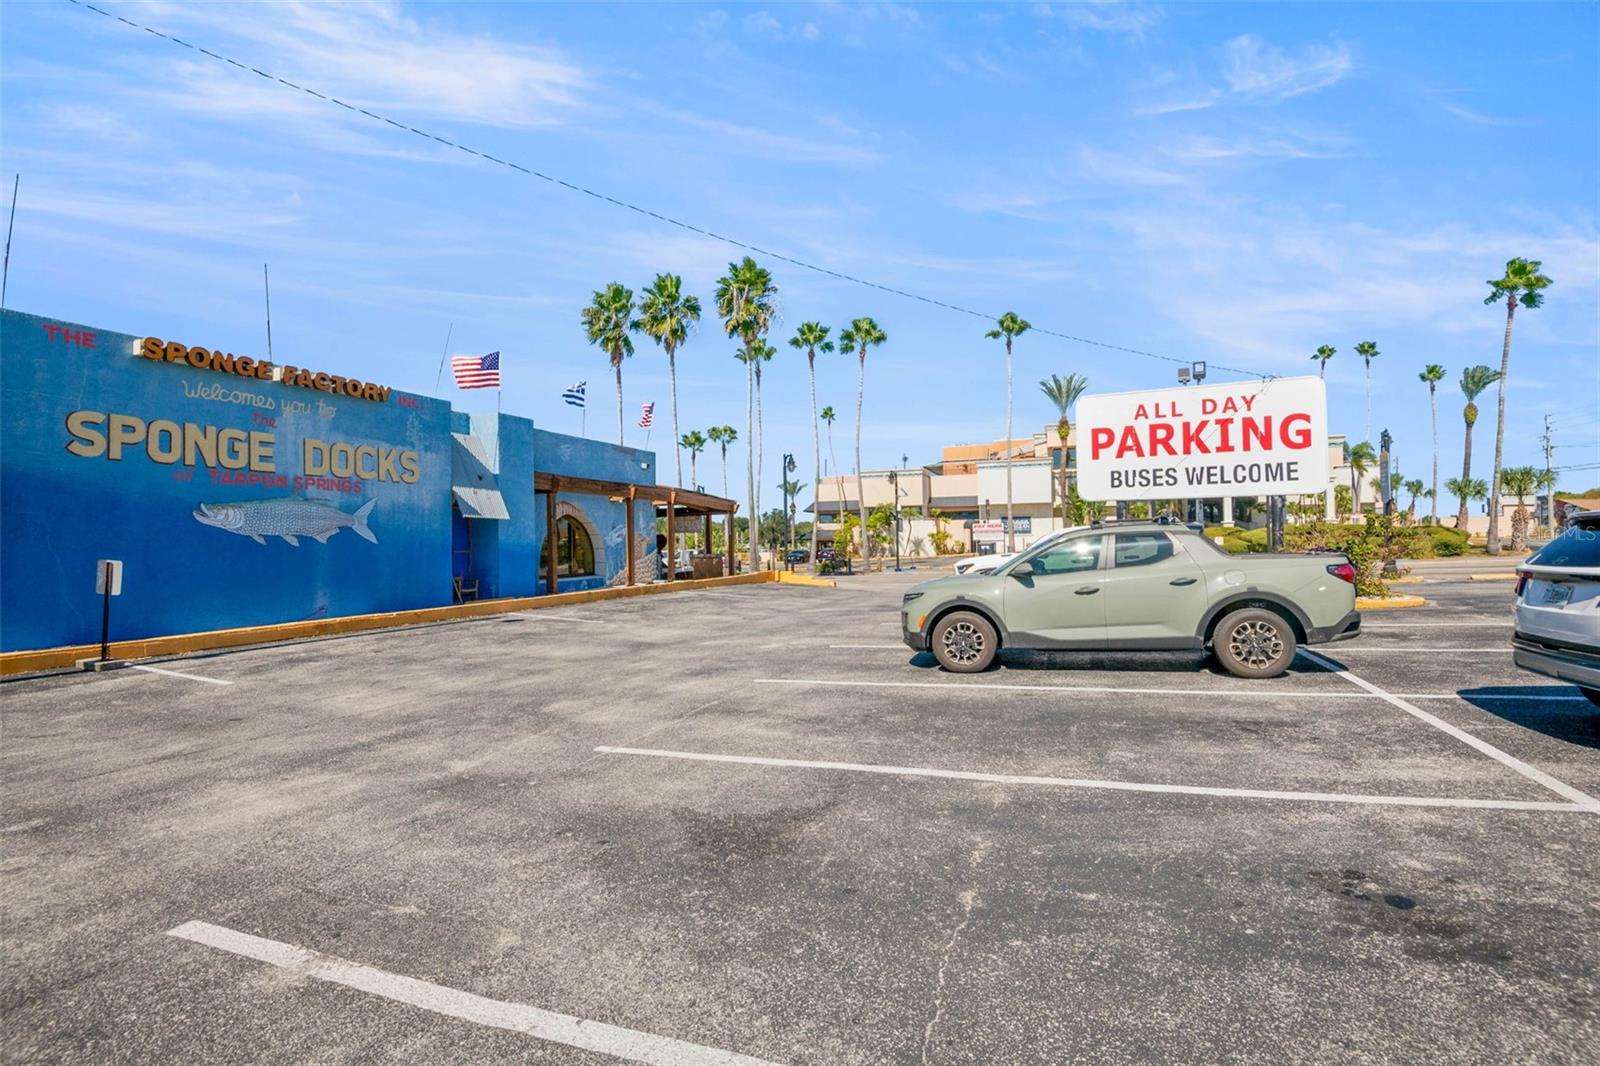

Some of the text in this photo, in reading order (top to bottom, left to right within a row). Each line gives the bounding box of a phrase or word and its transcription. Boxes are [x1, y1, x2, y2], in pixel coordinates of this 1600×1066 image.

[43, 323, 97, 349] THE
[142, 336, 274, 381] SPONGE
[282, 365, 392, 402] FACTORY
[181, 380, 336, 418] Welcomes you to
[1134, 394, 1256, 421] ALL DAY
[65, 410, 420, 484] SPONGE DOCKS
[1090, 413, 1312, 461] PARKING
[208, 469, 289, 489] TARPON
[292, 476, 362, 494] SPRINGS
[1110, 461, 1299, 489] BUSES WELCOME
